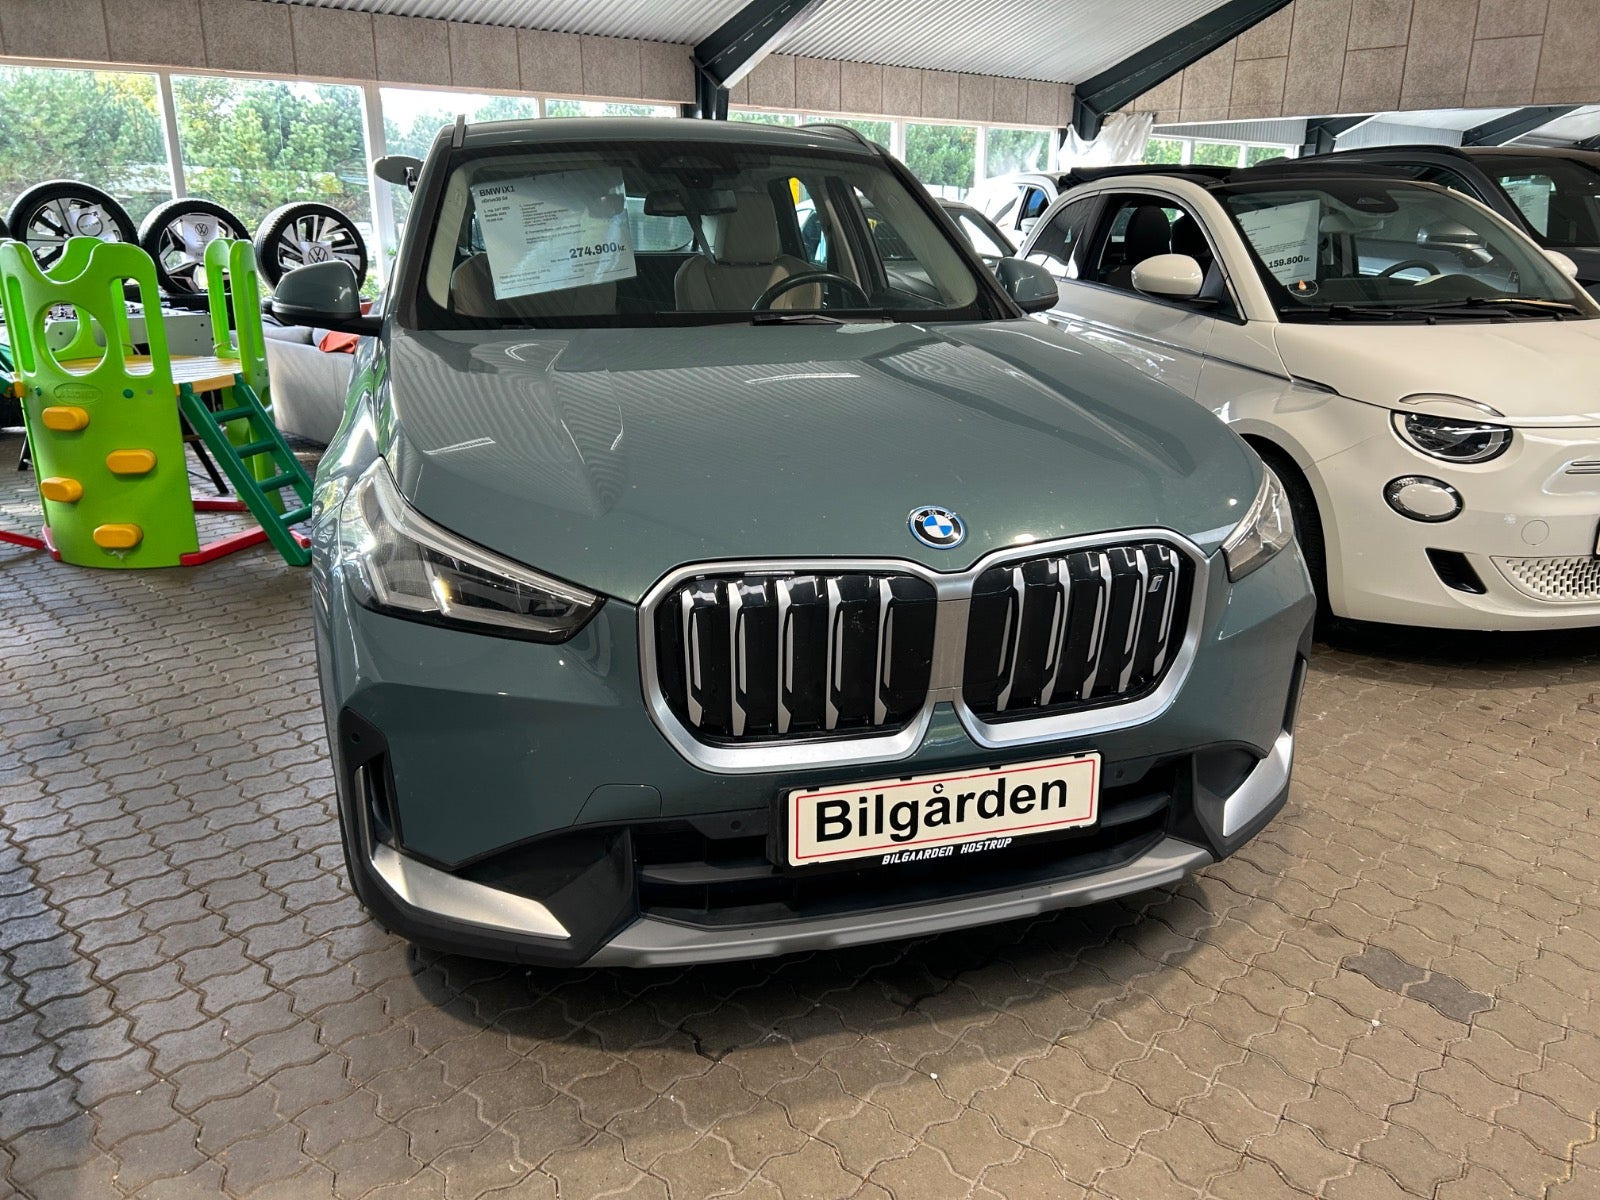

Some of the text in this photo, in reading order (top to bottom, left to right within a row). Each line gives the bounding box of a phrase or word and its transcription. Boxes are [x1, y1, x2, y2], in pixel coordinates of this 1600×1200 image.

[480, 187, 500, 196] BMW
[569, 242, 617, 259] 274.900
[1268, 255, 1303, 269] 159.800
[816, 778, 1067, 843] Bilgården
[882, 837, 1012, 865] BILGAARDEN HOSTRUP
